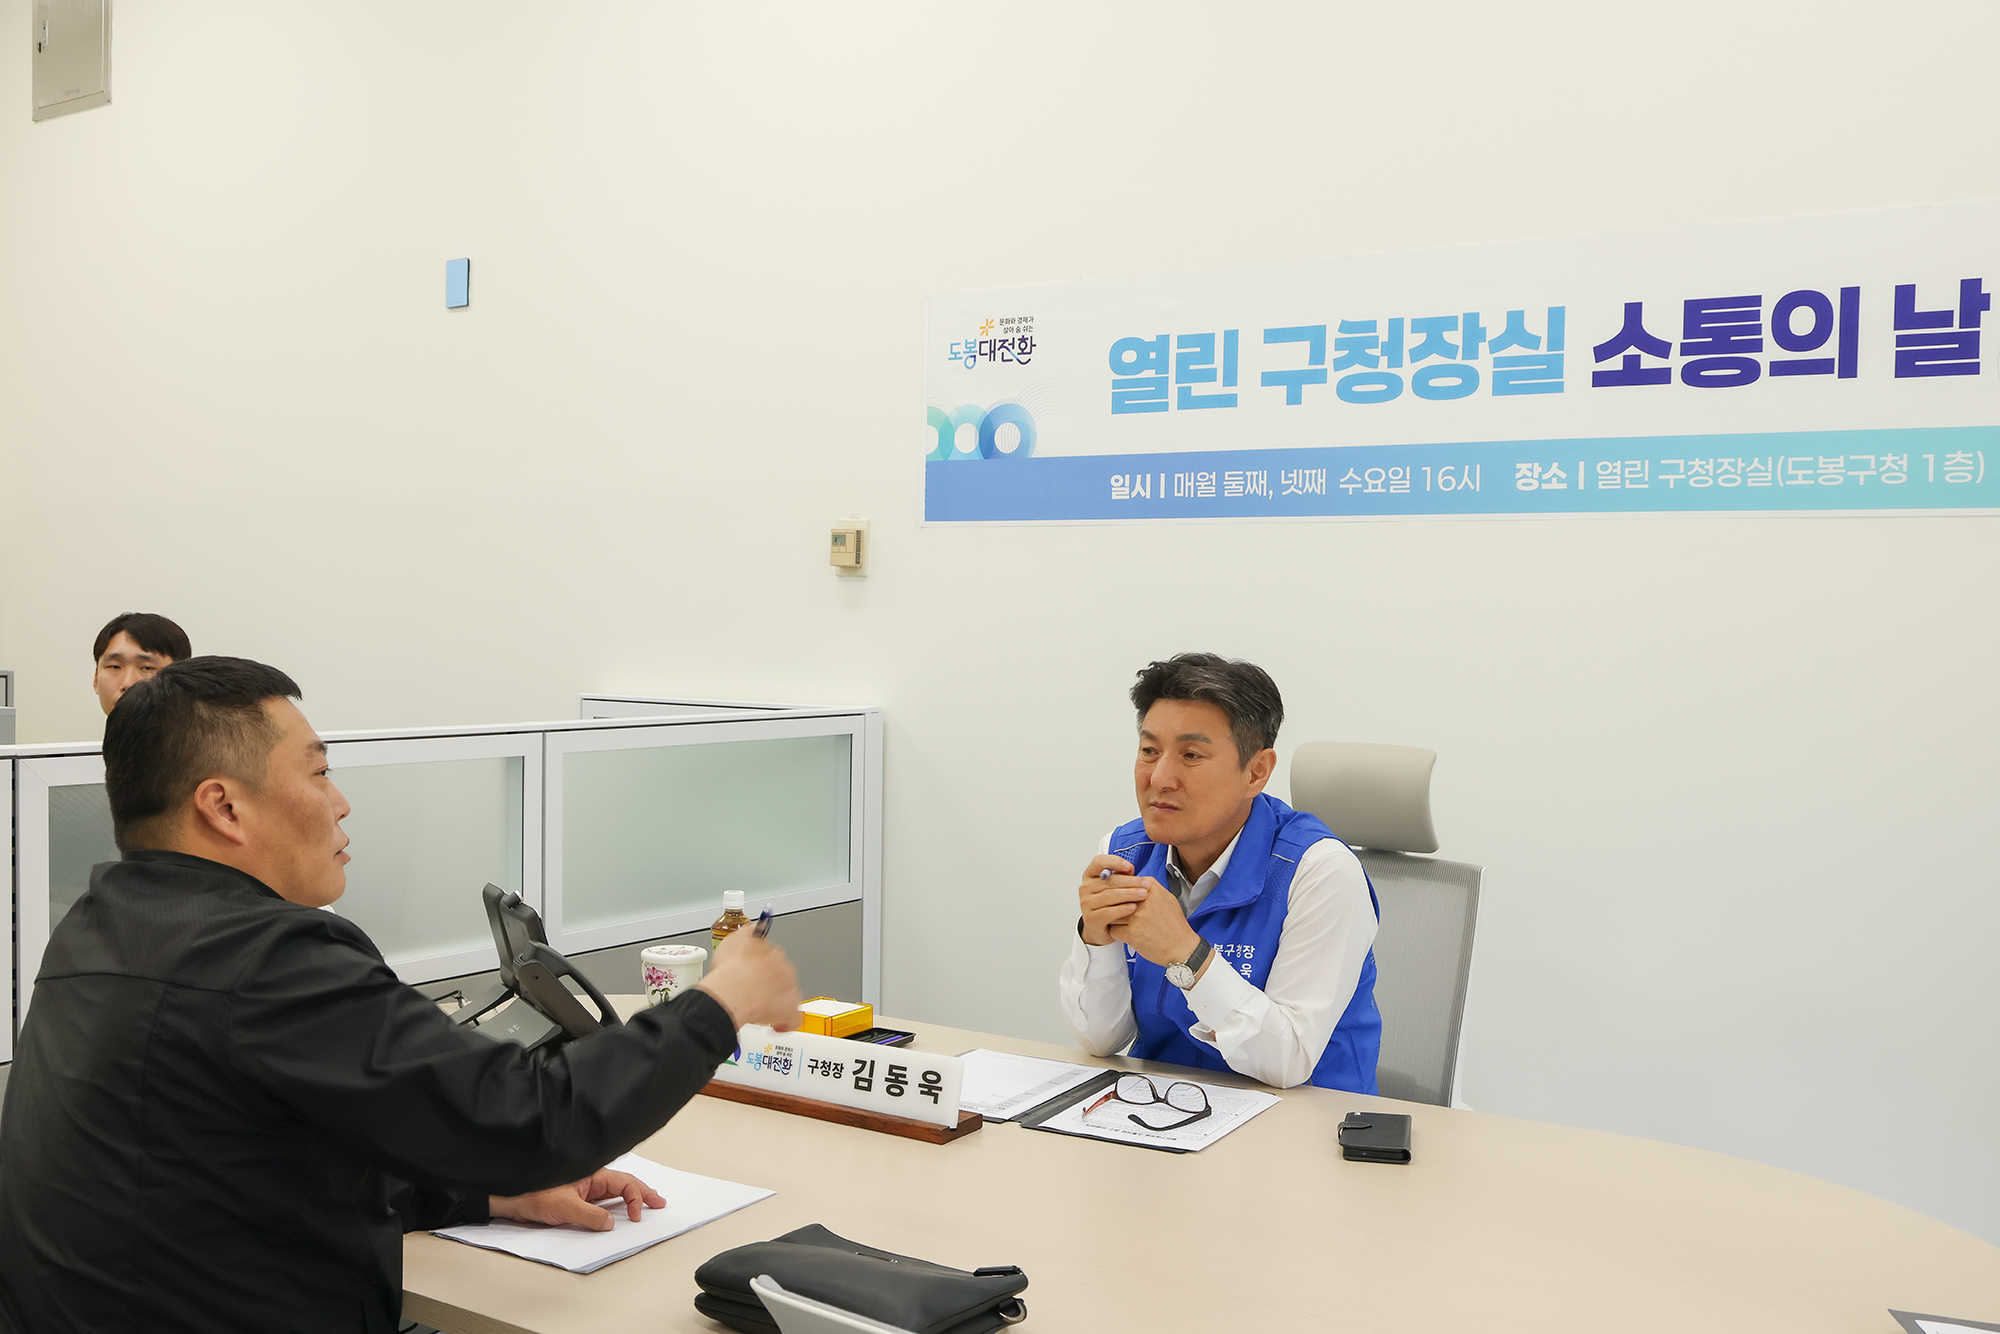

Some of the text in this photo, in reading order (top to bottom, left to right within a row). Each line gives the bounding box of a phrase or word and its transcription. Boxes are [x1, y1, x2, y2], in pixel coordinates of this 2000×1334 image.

[947, 334, 1037, 370] 도봉대전환
[1108, 277, 1991, 415] 열린 구청장실 소통의 날
[1110, 450, 1985, 500] 일시 매월 둘째, 넷째 수요일 16시 장소 열린 구청장실(도봉구청 1층)
[746, 1052, 793, 1076] 도봉대전환
[807, 1058, 844, 1079] 구청장
